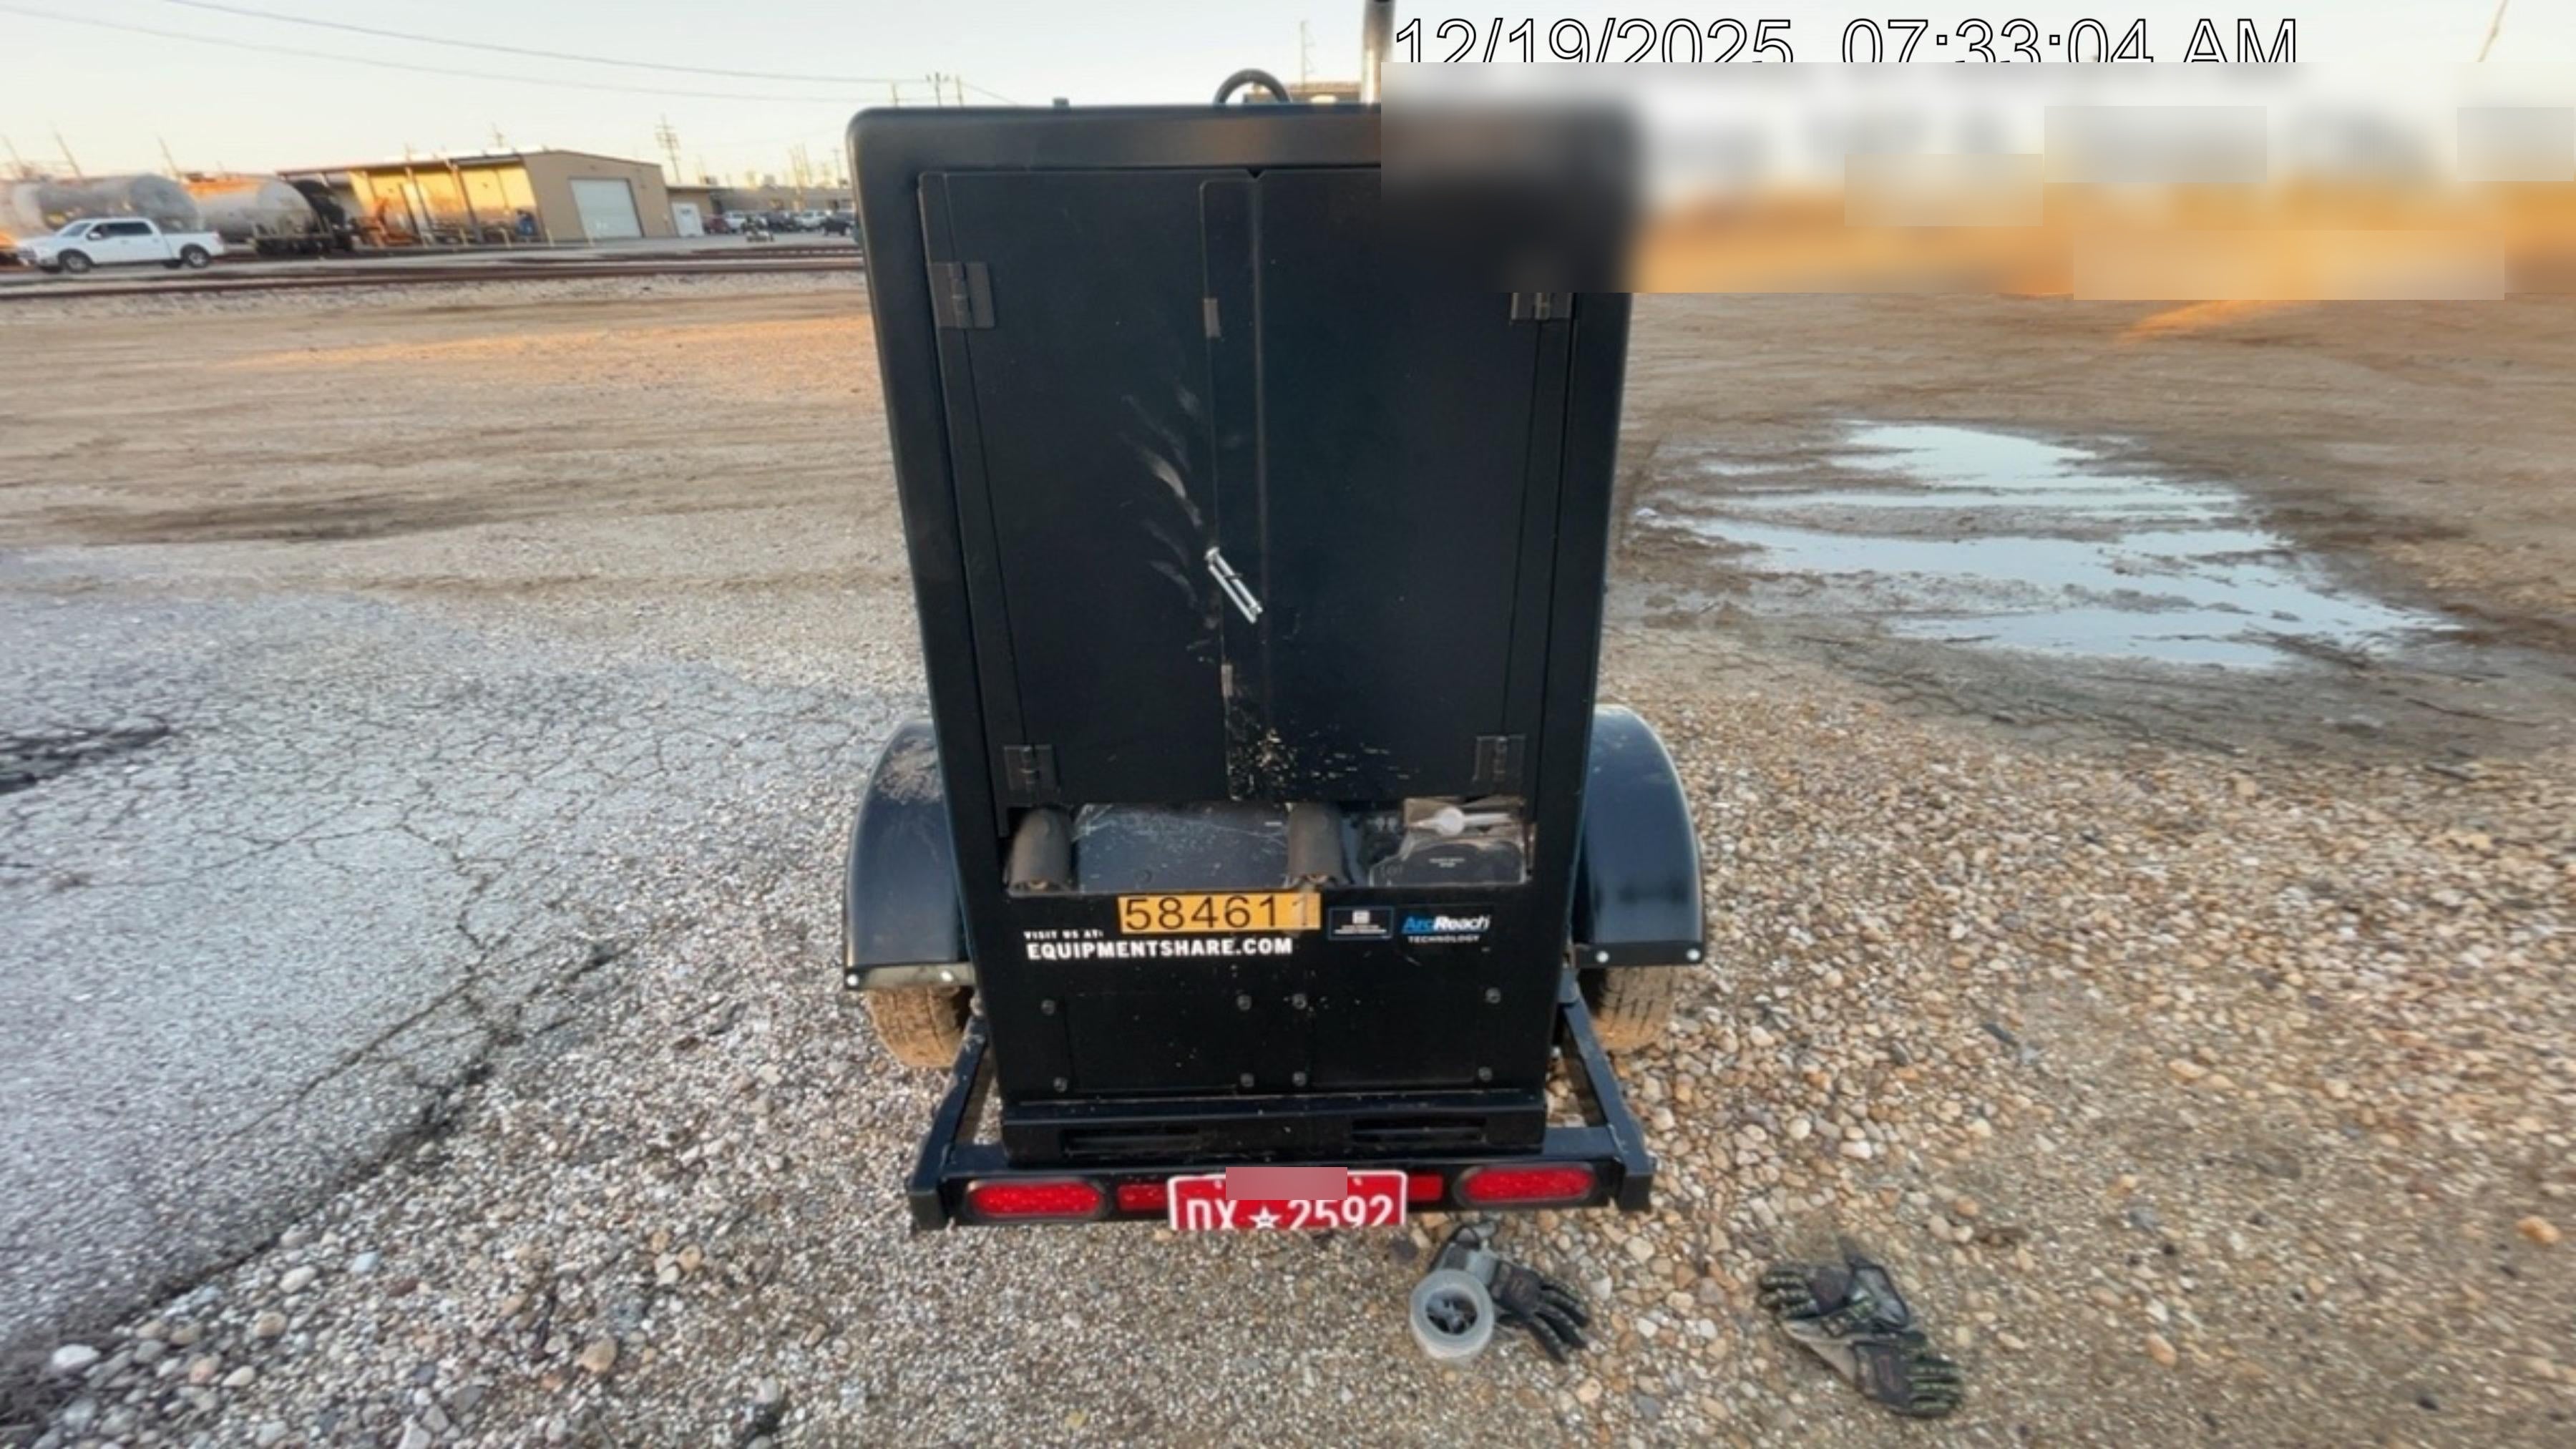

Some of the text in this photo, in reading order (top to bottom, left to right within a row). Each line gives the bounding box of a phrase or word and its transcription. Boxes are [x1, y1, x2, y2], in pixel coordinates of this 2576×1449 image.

[1125, 894, 1309, 931] 584611
[1402, 914, 1491, 933] ArcReach
[1023, 930, 1058, 940] VISIT
[1407, 935, 1480, 943] TECHNOLOGY
[1026, 937, 1294, 960] EQUIPMENTSHARE.COM
[1287, 1194, 1394, 1230] 2592
